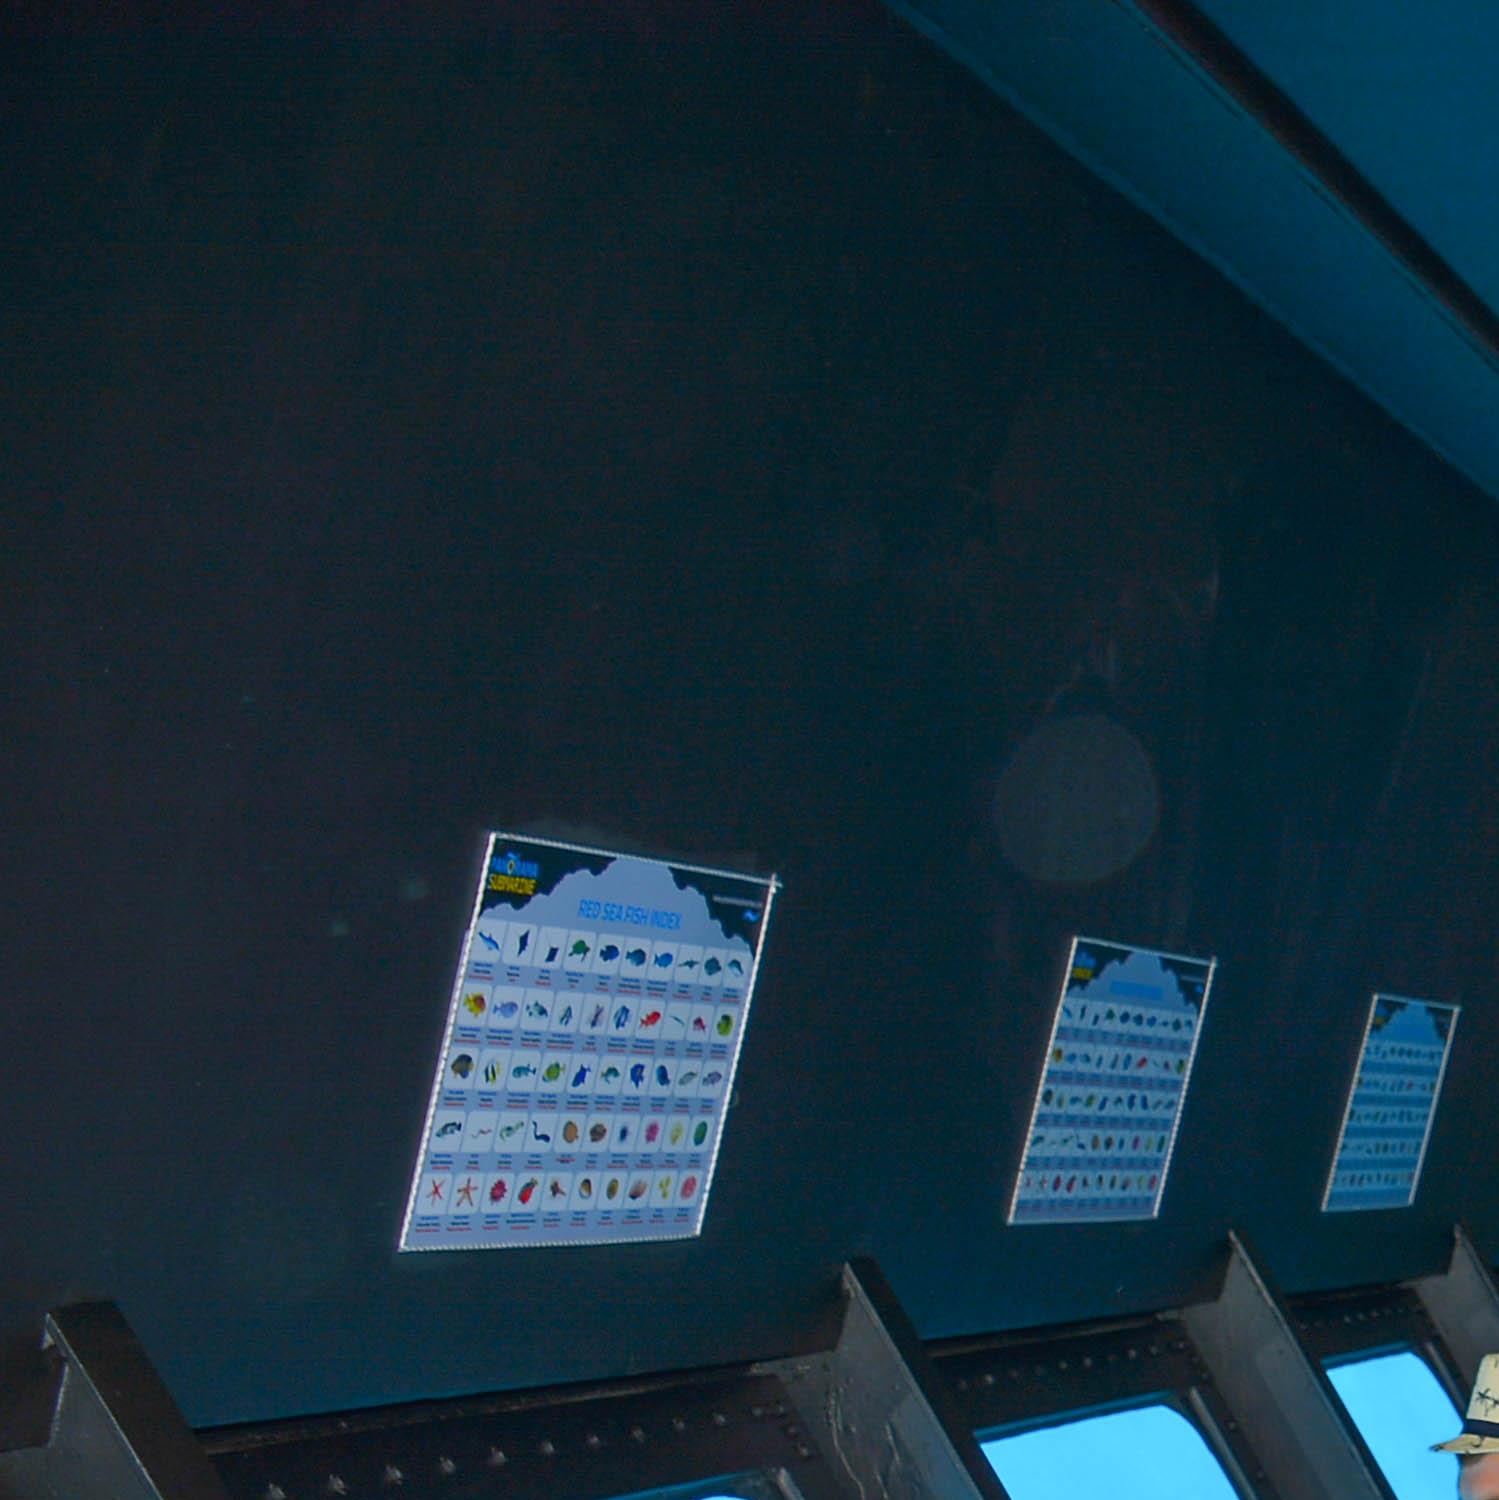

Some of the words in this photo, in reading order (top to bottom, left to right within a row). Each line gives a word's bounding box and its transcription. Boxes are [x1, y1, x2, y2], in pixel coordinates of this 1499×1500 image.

[578, 899, 600, 919] RED
[602, 903, 624, 921] SEA
[625, 905, 649, 926] FISH
